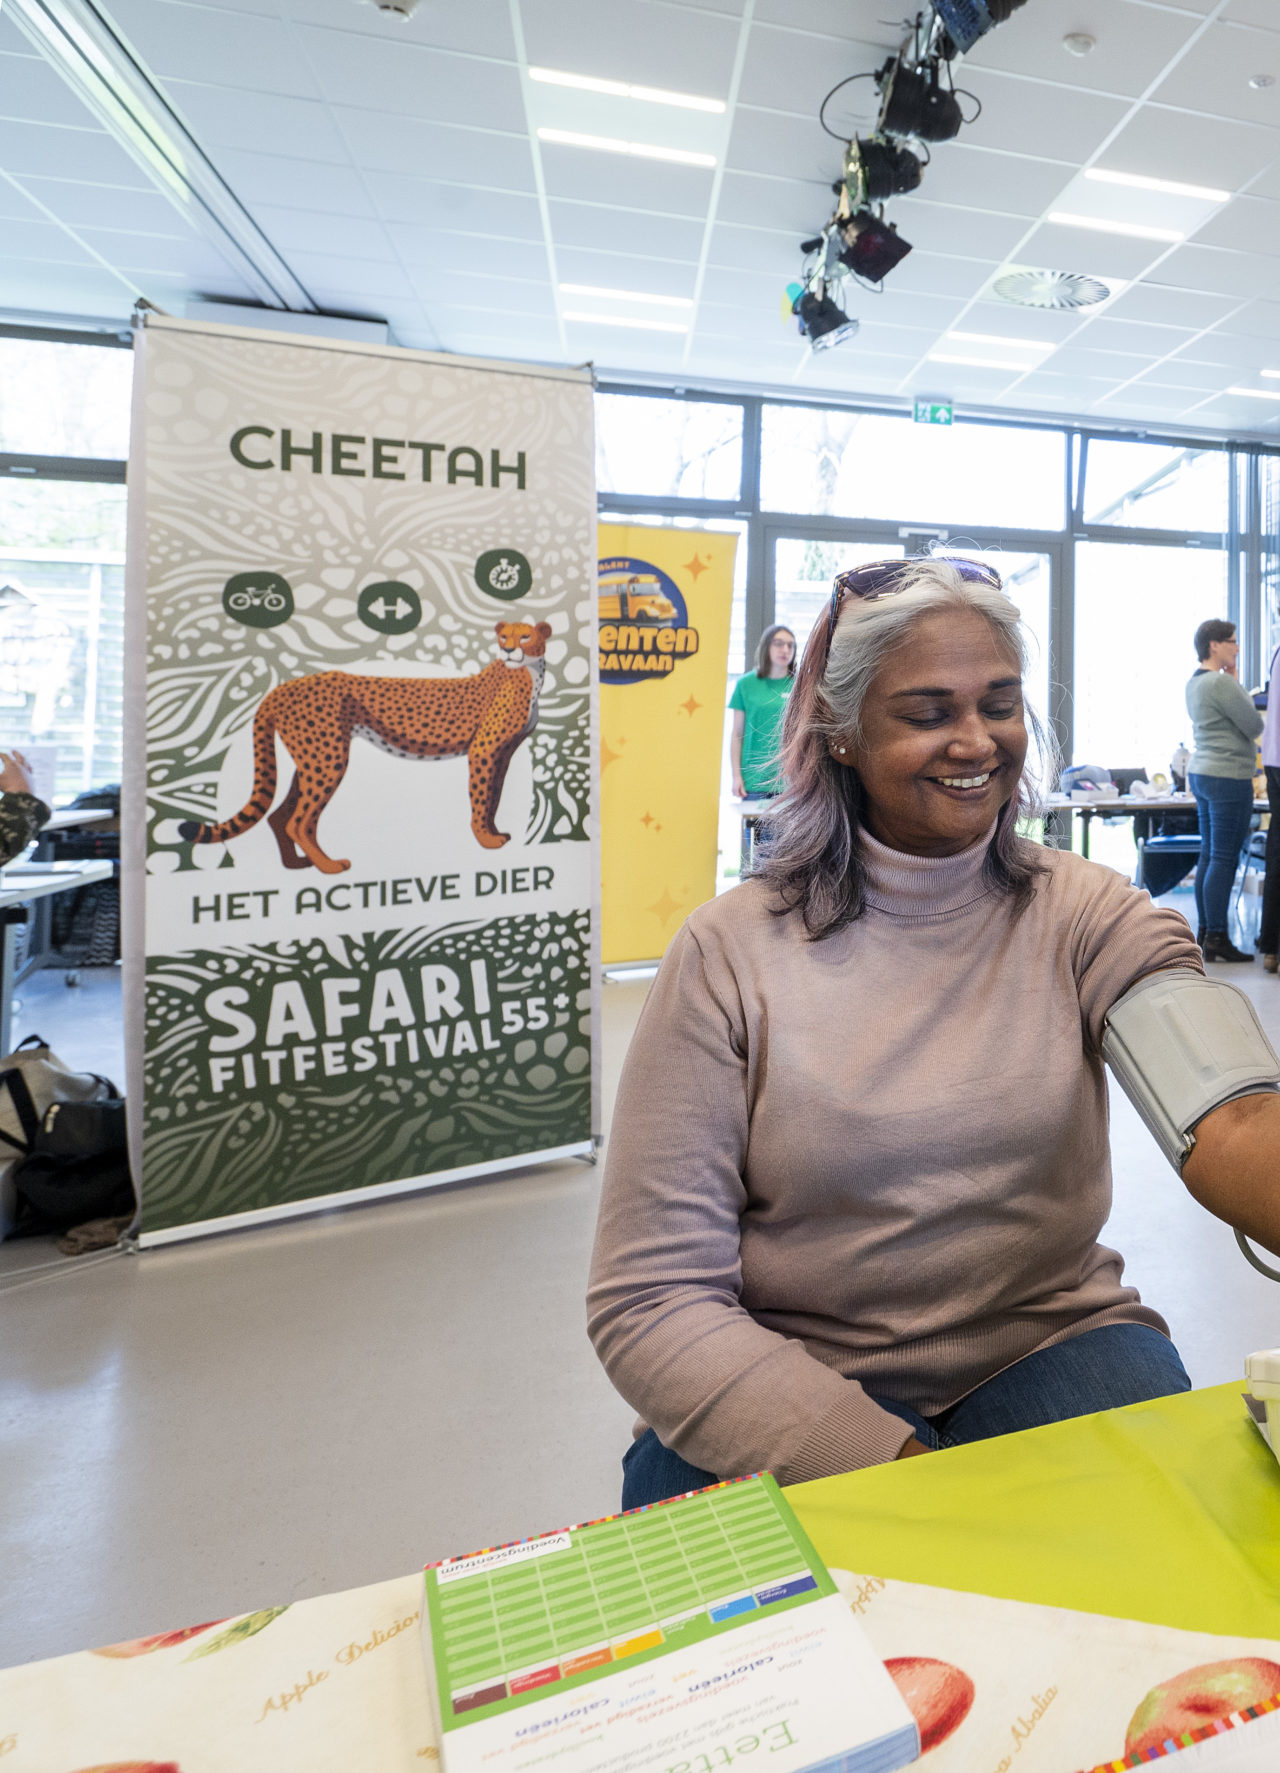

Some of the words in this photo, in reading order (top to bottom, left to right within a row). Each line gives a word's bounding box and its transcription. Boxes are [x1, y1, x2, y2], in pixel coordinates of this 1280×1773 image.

[230, 425, 526, 490] CHEETAH
[192, 890, 279, 924] HET
[295, 874, 460, 914] ACTIEVE
[475, 866, 554, 897] DIER
[204, 959, 490, 1052] SAFARI
[208, 1018, 500, 1093] FITFESTIVAL
[501, 993, 569, 1036] 55+
[441, 1536, 566, 1575] Voedingscentrum
[254, 1670, 331, 1724] Apple
[688, 1655, 775, 1693] calorieën
[515, 1698, 610, 1738] calorieën
